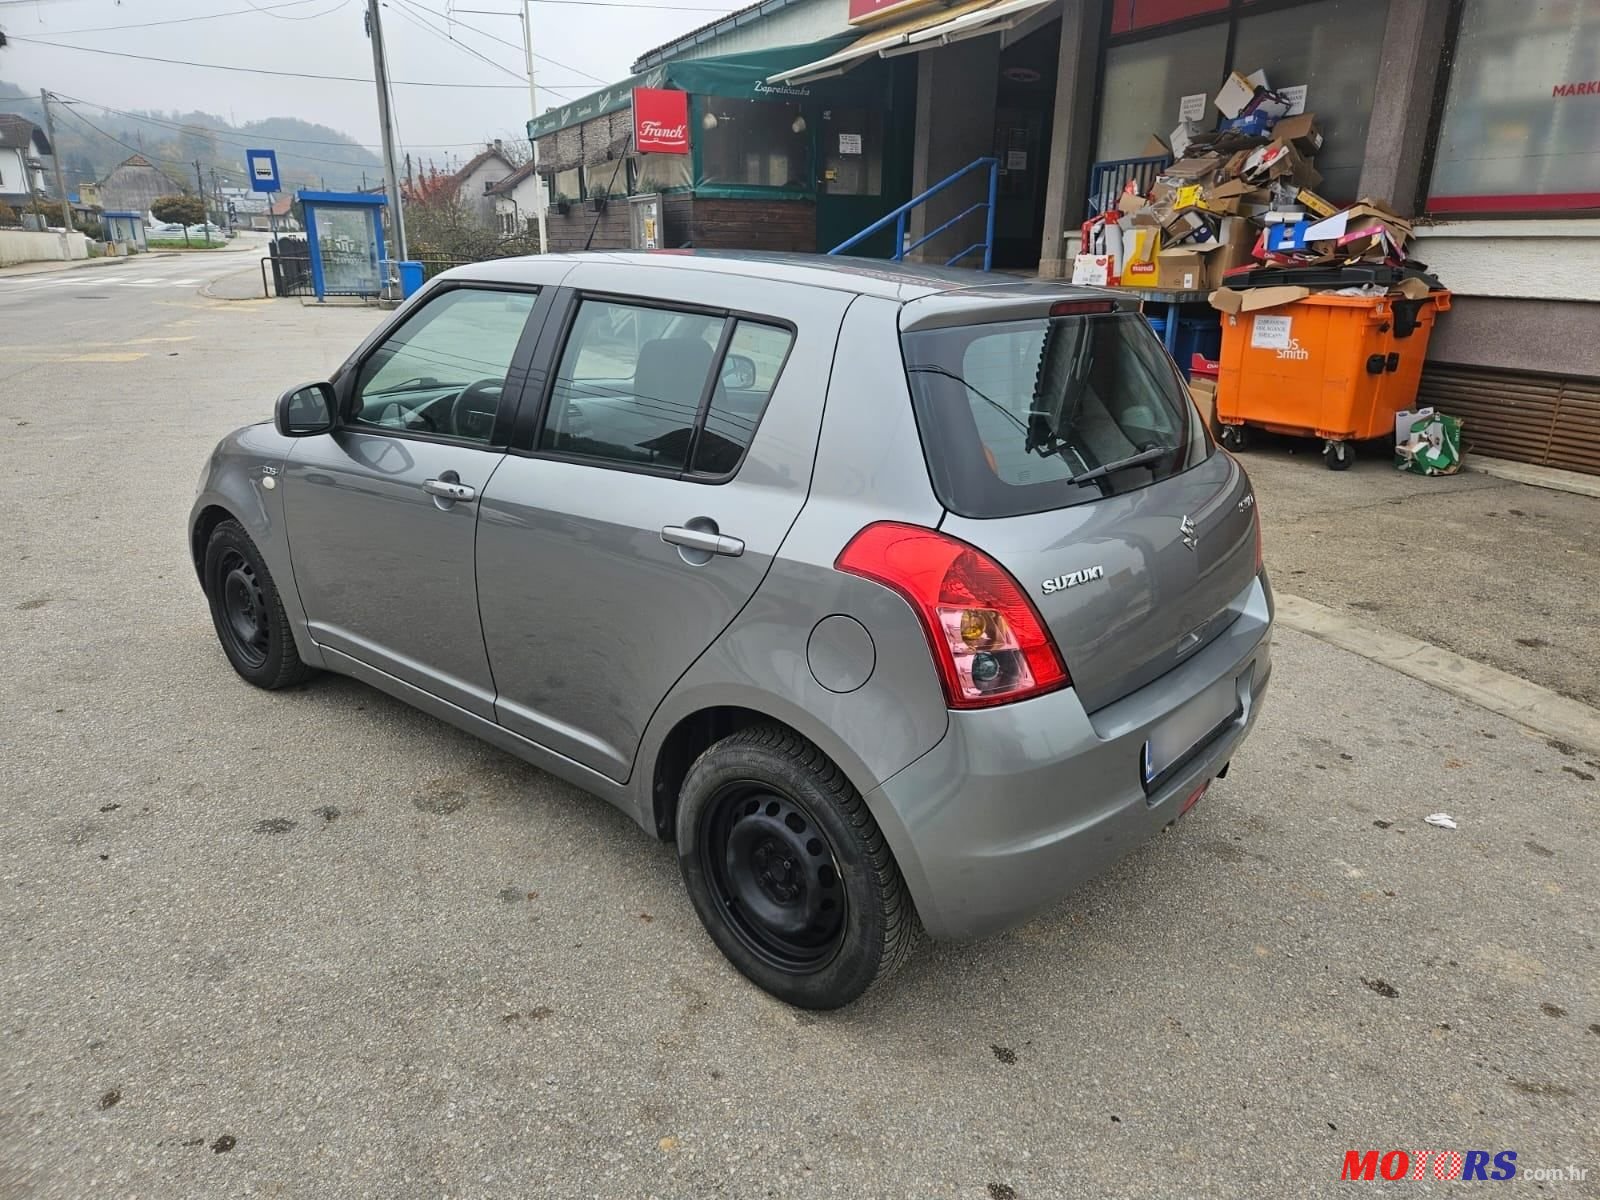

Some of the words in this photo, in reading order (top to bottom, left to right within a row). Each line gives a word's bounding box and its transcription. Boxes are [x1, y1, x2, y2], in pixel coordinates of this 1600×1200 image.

[639, 120, 686, 139] Franck
[1276, 348, 1309, 360] Smith
[1041, 565, 1104, 595] SUZUKI
